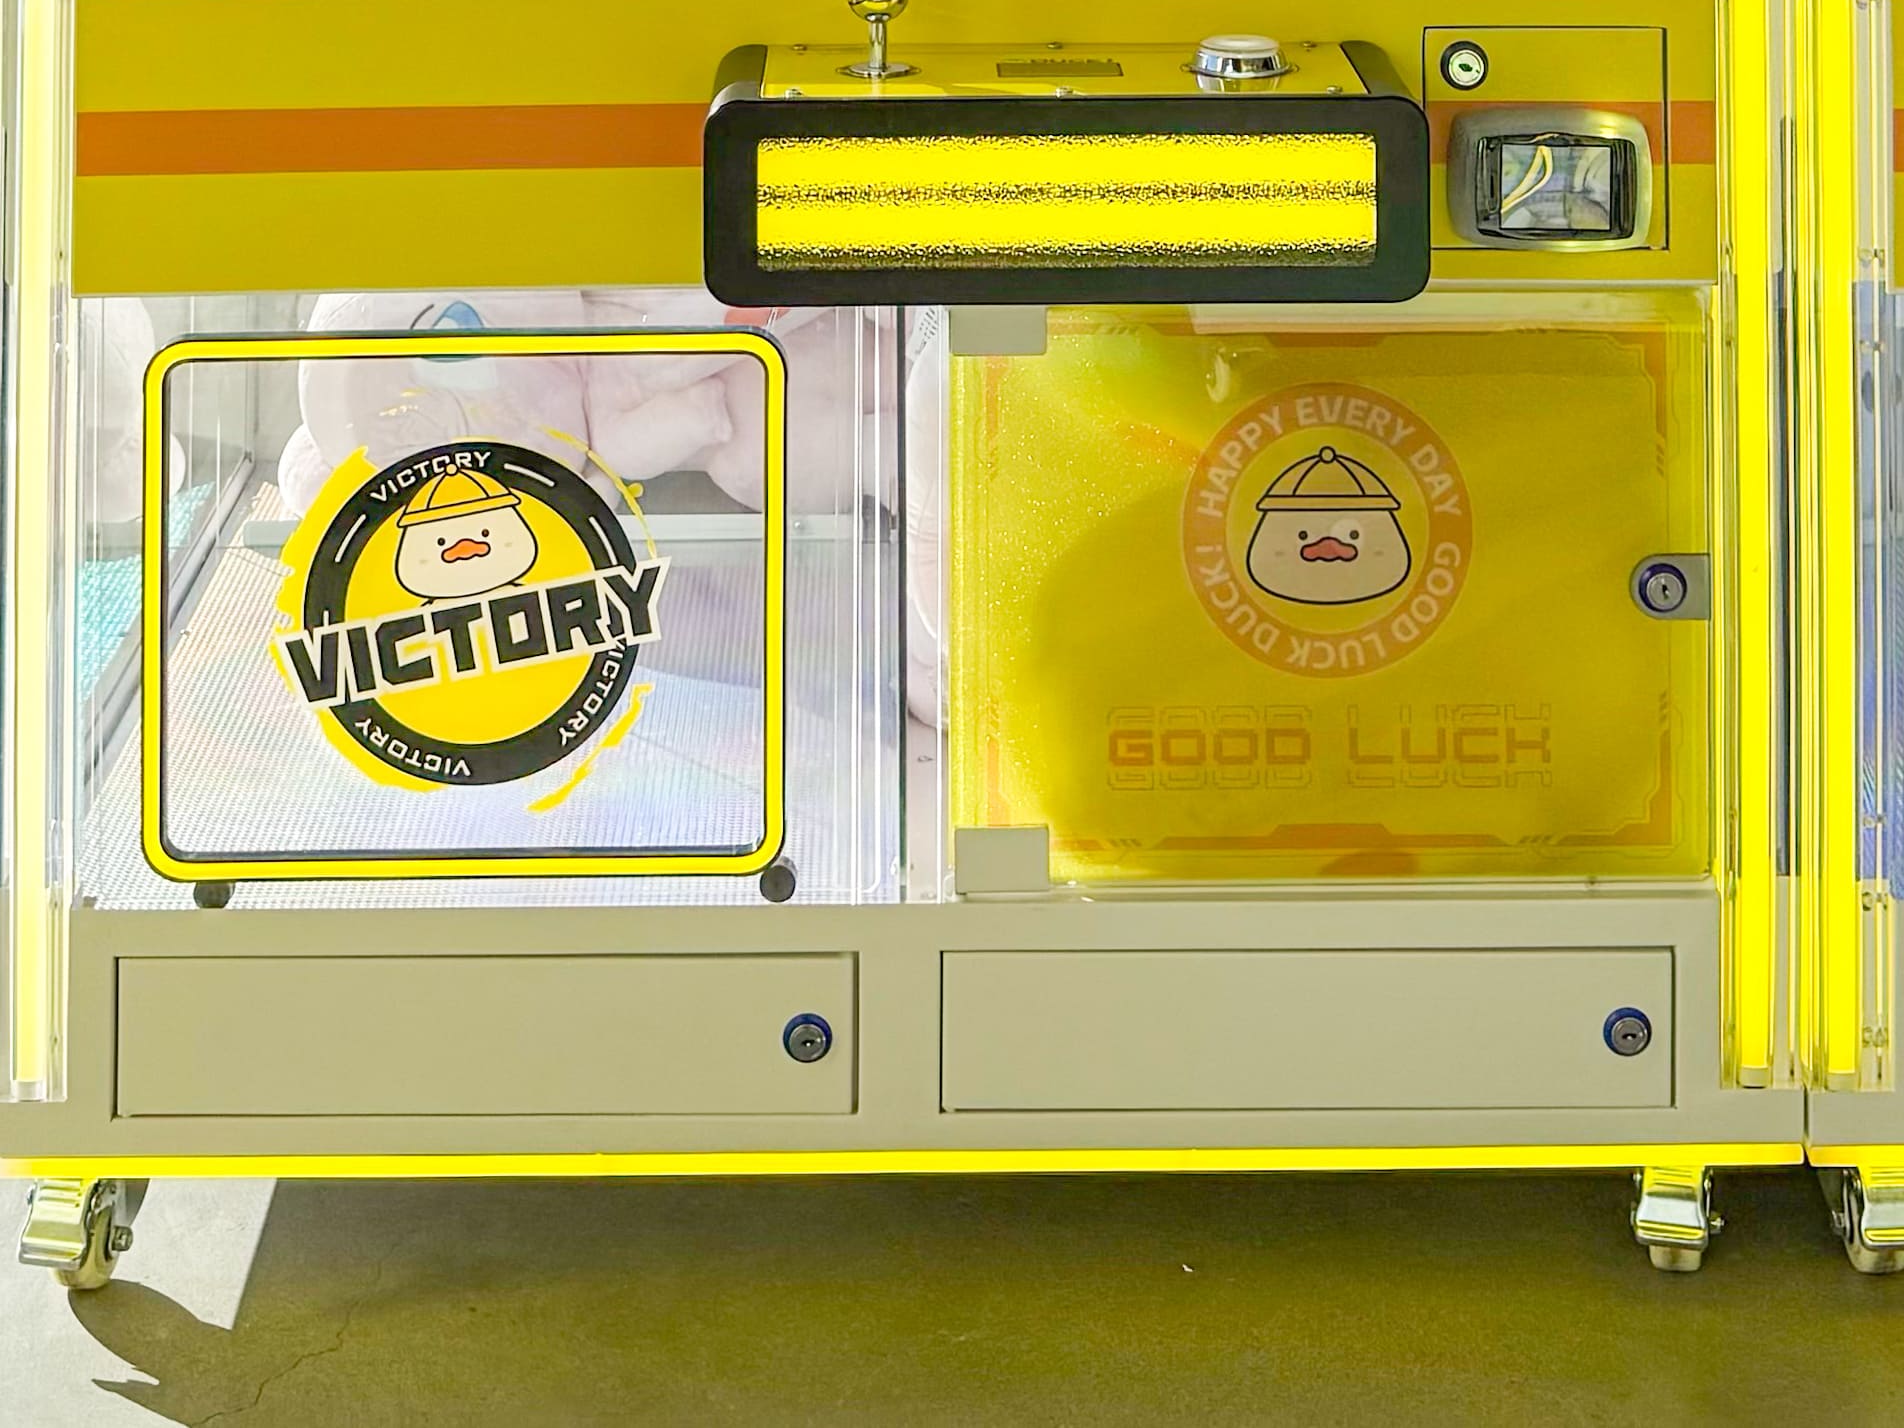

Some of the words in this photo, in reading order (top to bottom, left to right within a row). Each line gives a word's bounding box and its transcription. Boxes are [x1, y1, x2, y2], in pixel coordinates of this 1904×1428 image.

[369, 450, 492, 503] VICTORY
[1198, 405, 1284, 519] HAPPY
[1297, 394, 1416, 445] EVERY
[1409, 443, 1462, 518] DAY
[1397, 540, 1462, 644] GOOD
[281, 562, 667, 707] VICTORY
[1288, 628, 1389, 671] LUCK
[354, 716, 471, 778] VICTORY
[1108, 726, 1313, 767] GOOD
